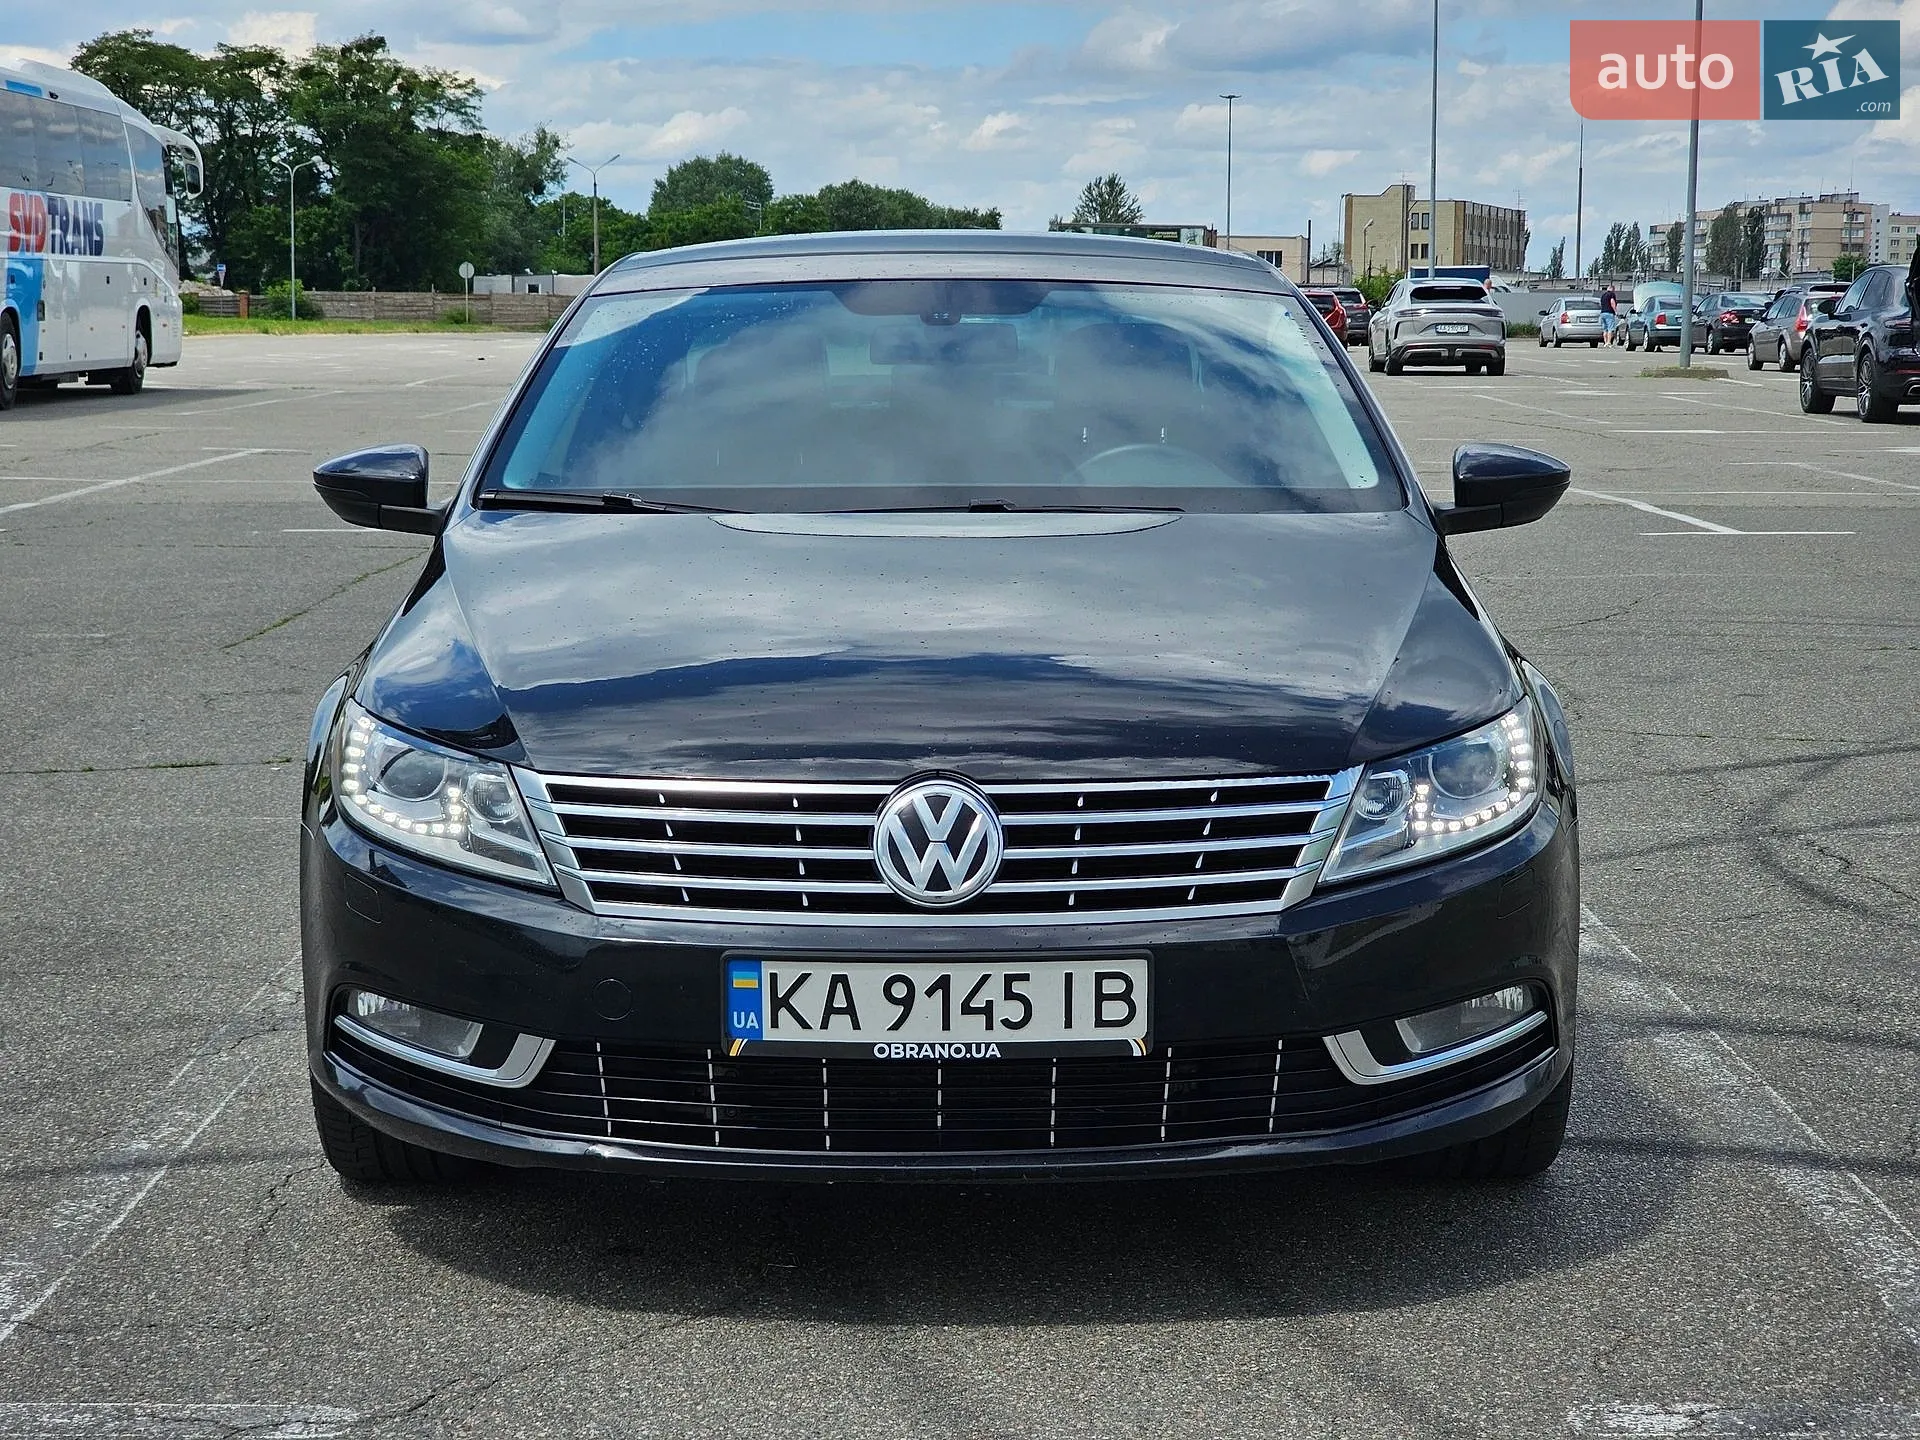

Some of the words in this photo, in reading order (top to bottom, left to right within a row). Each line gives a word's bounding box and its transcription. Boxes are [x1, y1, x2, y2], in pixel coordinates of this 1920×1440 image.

[9, 192, 46, 253] SVD
[47, 196, 104, 256] TRANS
[733, 1011, 759, 1029] UA
[769, 972, 862, 1030] KA
[883, 973, 1033, 1031] 9145
[1064, 972, 1137, 1029] IB
[873, 1043, 1001, 1059] OBRANO.UA
